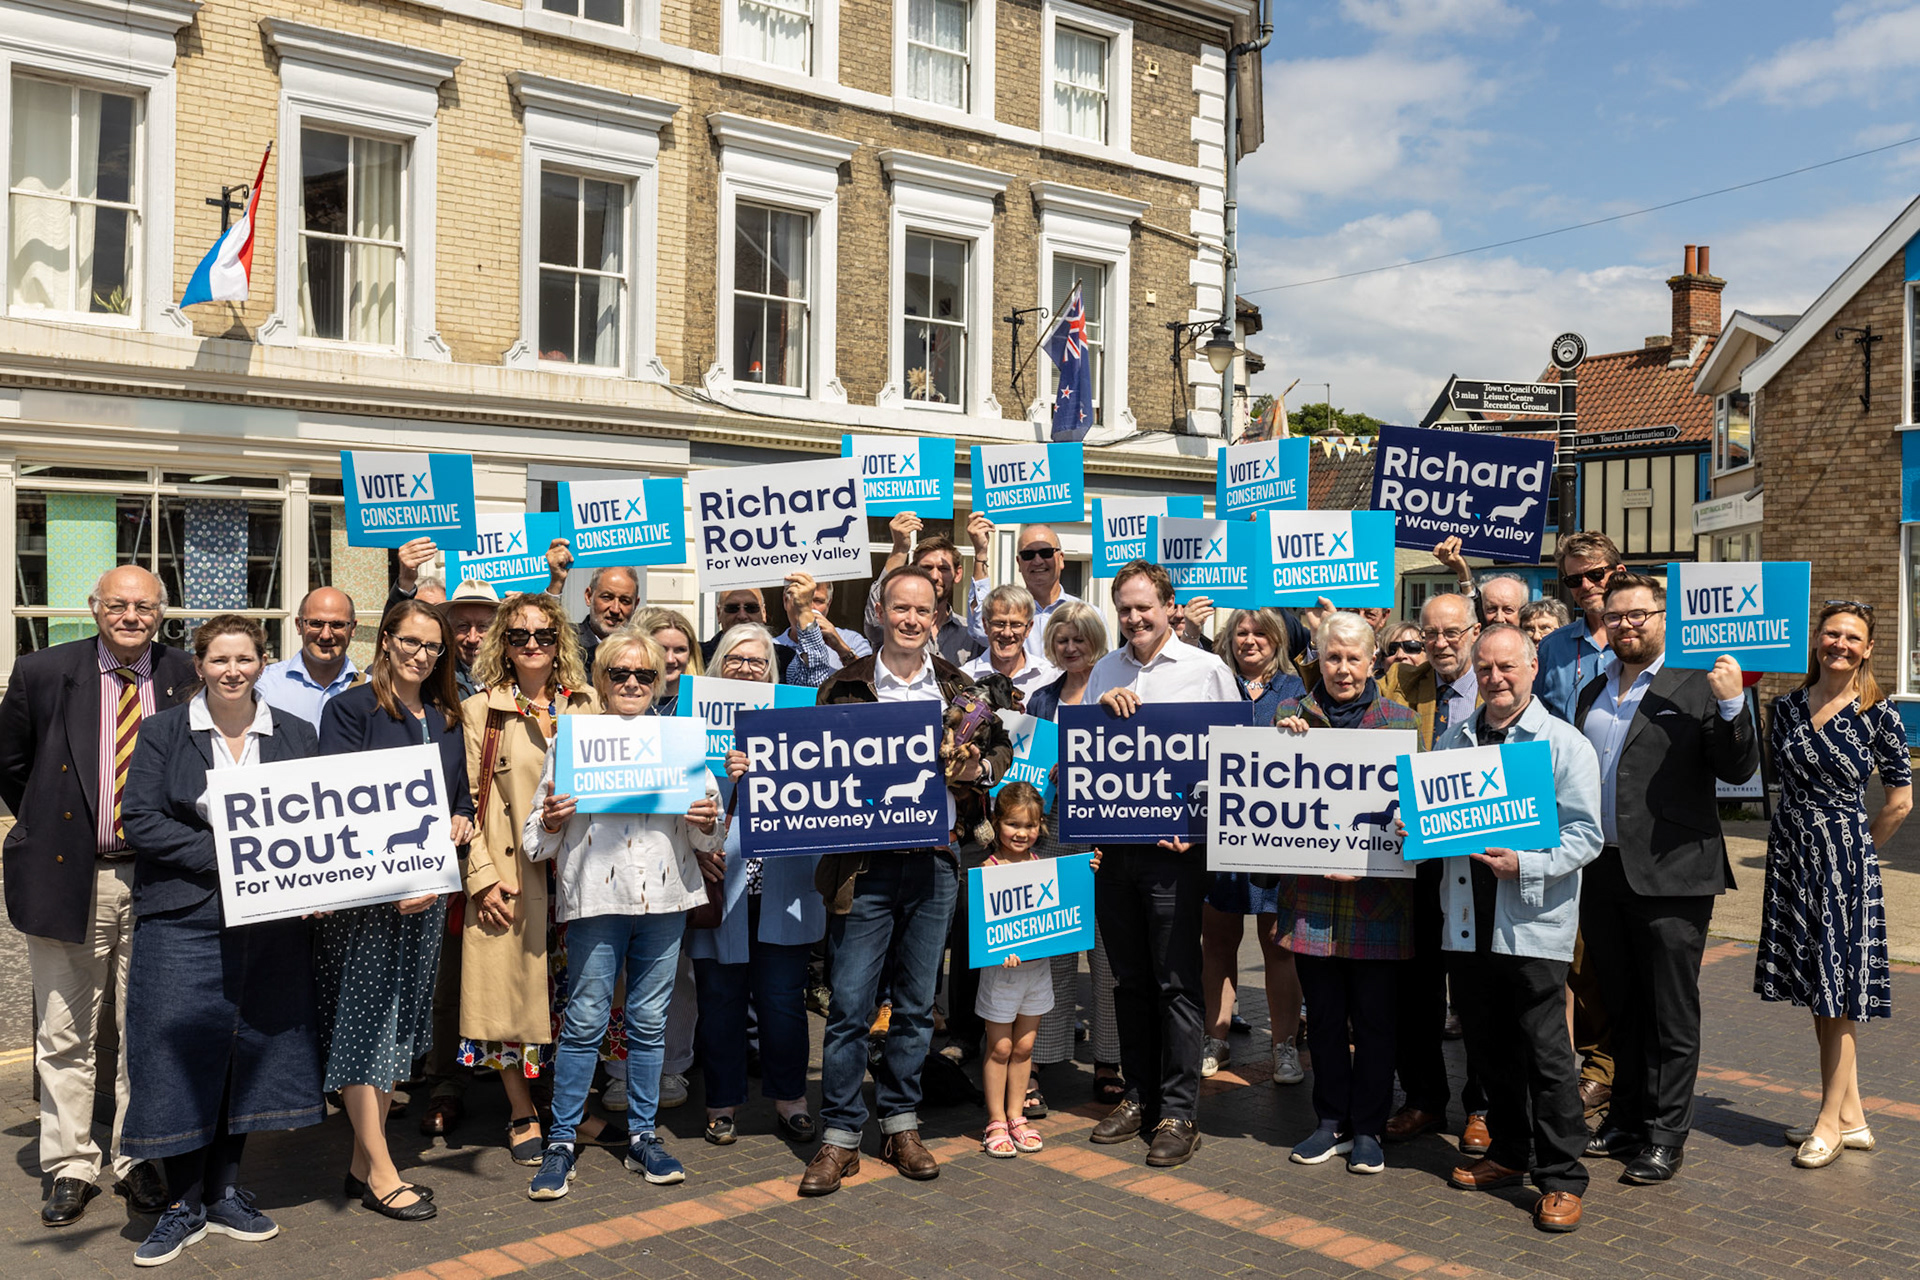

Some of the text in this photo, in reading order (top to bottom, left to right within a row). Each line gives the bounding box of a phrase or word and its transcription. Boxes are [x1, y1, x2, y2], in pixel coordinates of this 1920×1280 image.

[1461, 392, 1479, 400] mins
[1484, 384, 1556, 394] Town Council Offices
[1484, 392, 1534, 402] Leisure Centre
[1484, 400, 1549, 411] Recreation Ground
[1444, 424, 1464, 432] mins
[1469, 424, 1503, 432] Museum
[1600, 434, 1623, 443] Tourist
[1624, 431, 1665, 440] Information
[988, 462, 1027, 484] VOTE
[1230, 460, 1261, 483] VOTE
[1383, 446, 1545, 492] Richard
[361, 473, 407, 500] VOTE
[700, 478, 857, 521] Richard
[863, 479, 940, 498] ONSERVATIVE
[986, 483, 1072, 508] CONSERVATIVE
[1226, 479, 1296, 506] CONSERVATIVE
[1379, 479, 1474, 520] Rout
[360, 503, 461, 527] CONSERVATIVE
[578, 500, 622, 525] VOTE
[576, 523, 671, 550] CONSERVATIVE
[704, 520, 797, 554] Rout
[1108, 515, 1146, 538] VOTE
[1405, 514, 1480, 538] Waveney
[1483, 524, 1534, 544] Valley
[706, 546, 860, 570] For Waveney Valley
[1163, 538, 1202, 560] VOTE
[1277, 532, 1325, 559] VOTE
[461, 556, 549, 581] CONSERVATIVE
[1167, 566, 1248, 584] ONSERVATIVE
[1273, 561, 1380, 587] CONSERVATIVE
[1686, 586, 1734, 615] VOTE
[1682, 619, 1790, 646] CONSERVATIVE
[699, 701, 746, 726] VOT
[580, 737, 631, 764] VOTE
[746, 725, 936, 772] Richard
[1067, 725, 1209, 762] Richar
[574, 766, 688, 792] CONSERVATIVE
[1067, 767, 1172, 800] Rout
[1420, 772, 1475, 804] VOTE
[224, 769, 438, 832] Richard
[748, 773, 862, 813] Rout
[750, 808, 938, 832] For Waveney Valley
[1068, 804, 1095, 818] For
[1099, 804, 1183, 821] Waveney
[1219, 793, 1328, 830] Rout
[1420, 797, 1538, 836] CONSERVATIVE
[230, 824, 362, 875] Rout
[1218, 832, 1404, 854] For Waveney Valley
[235, 855, 446, 896] For Waveney Valley
[990, 884, 1034, 916] VOTE
[986, 906, 1081, 946] CONSERVATIVE
